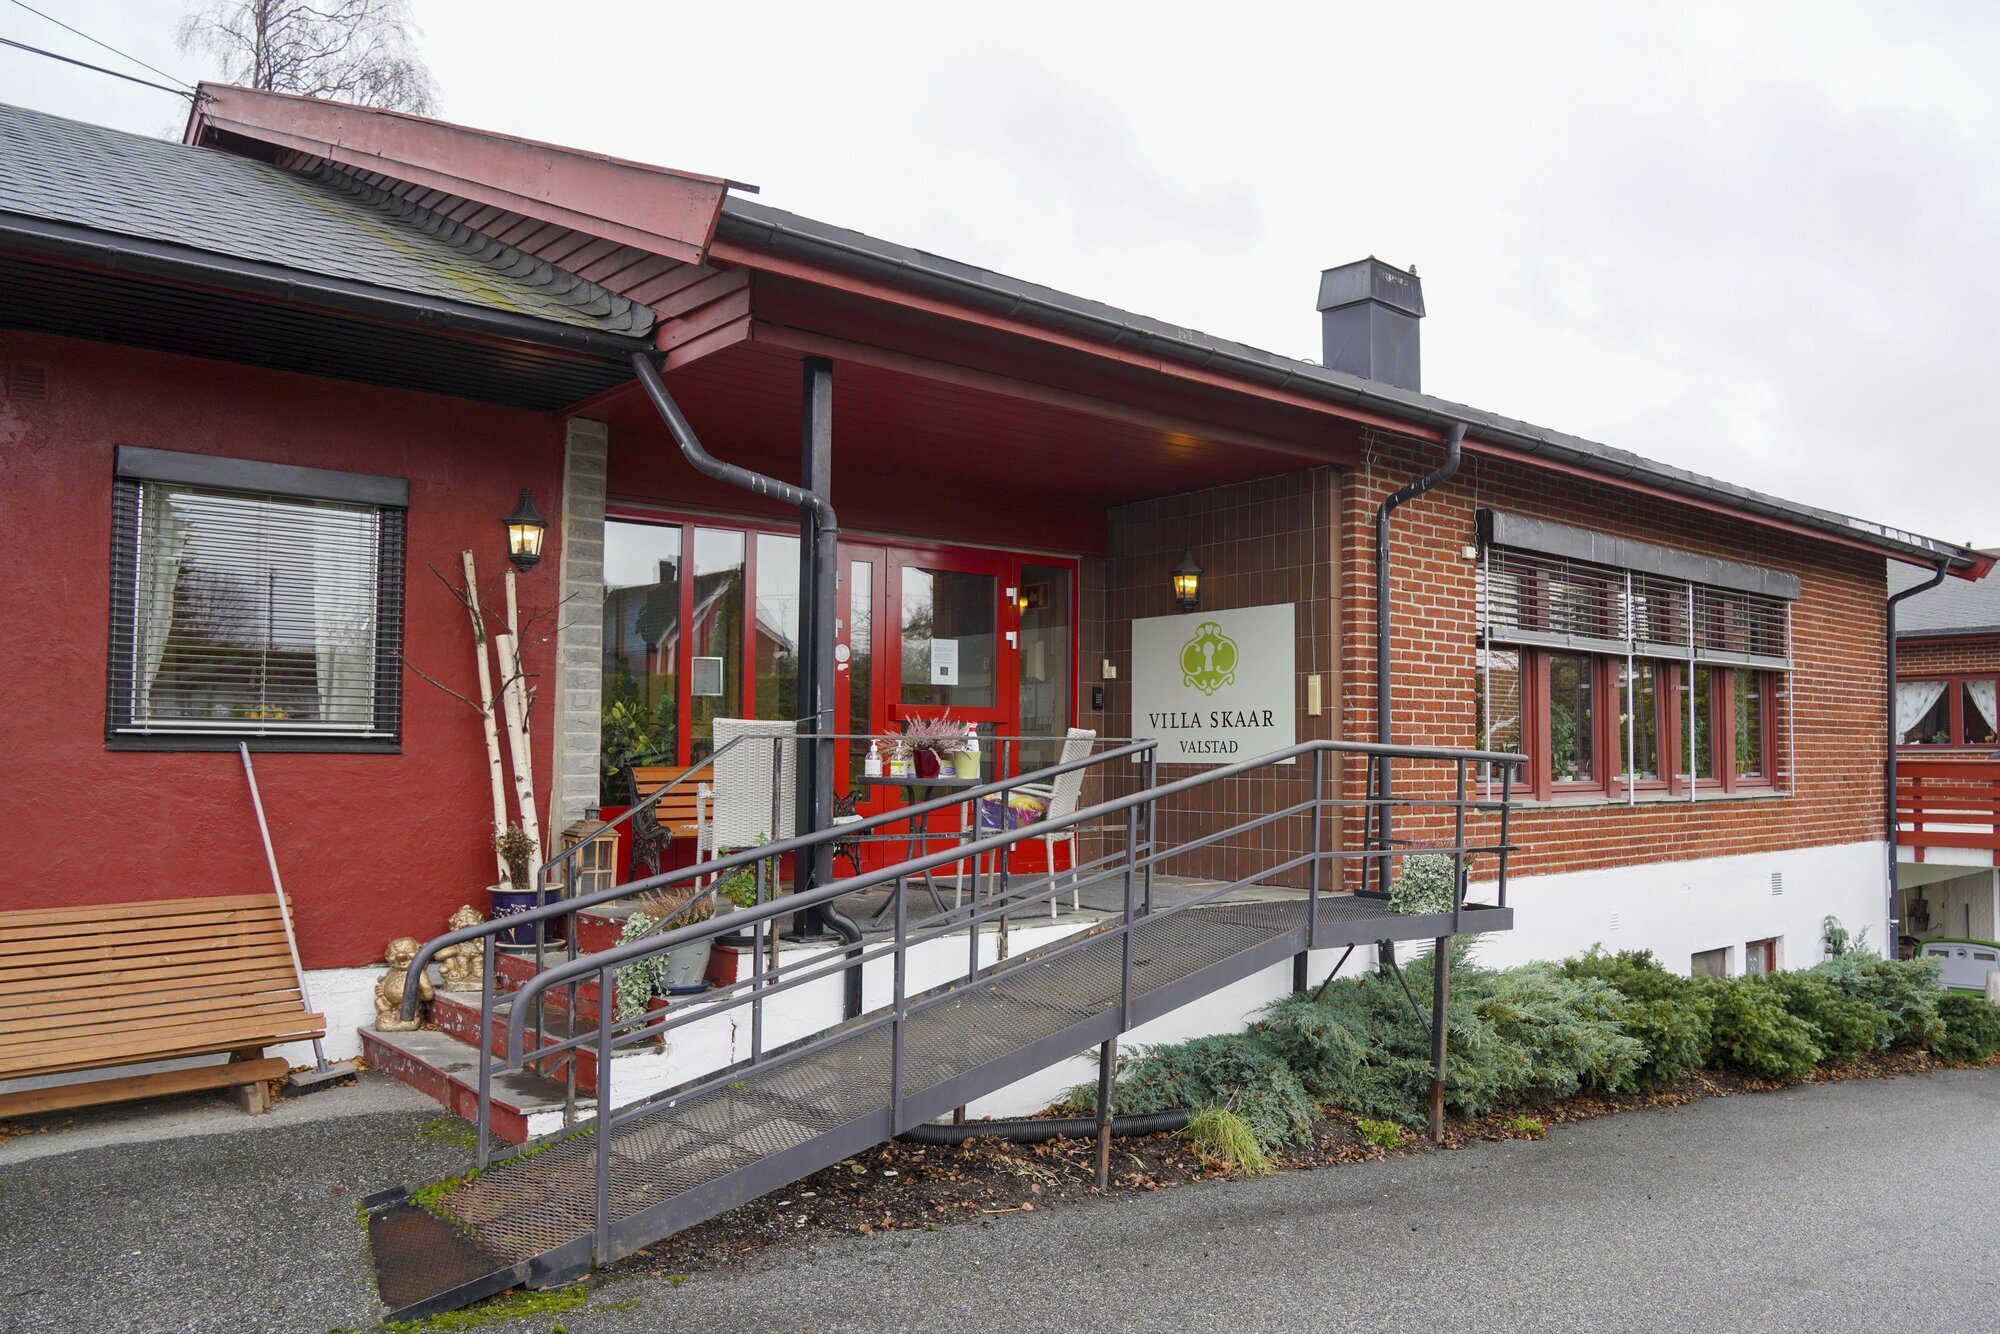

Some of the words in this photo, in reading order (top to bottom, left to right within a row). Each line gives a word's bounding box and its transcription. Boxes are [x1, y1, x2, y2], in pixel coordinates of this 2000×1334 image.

[1149, 712, 1202, 729] VILLA
[1211, 710, 1274, 728] SKAAR
[1180, 740, 1238, 753] VALSTAD
